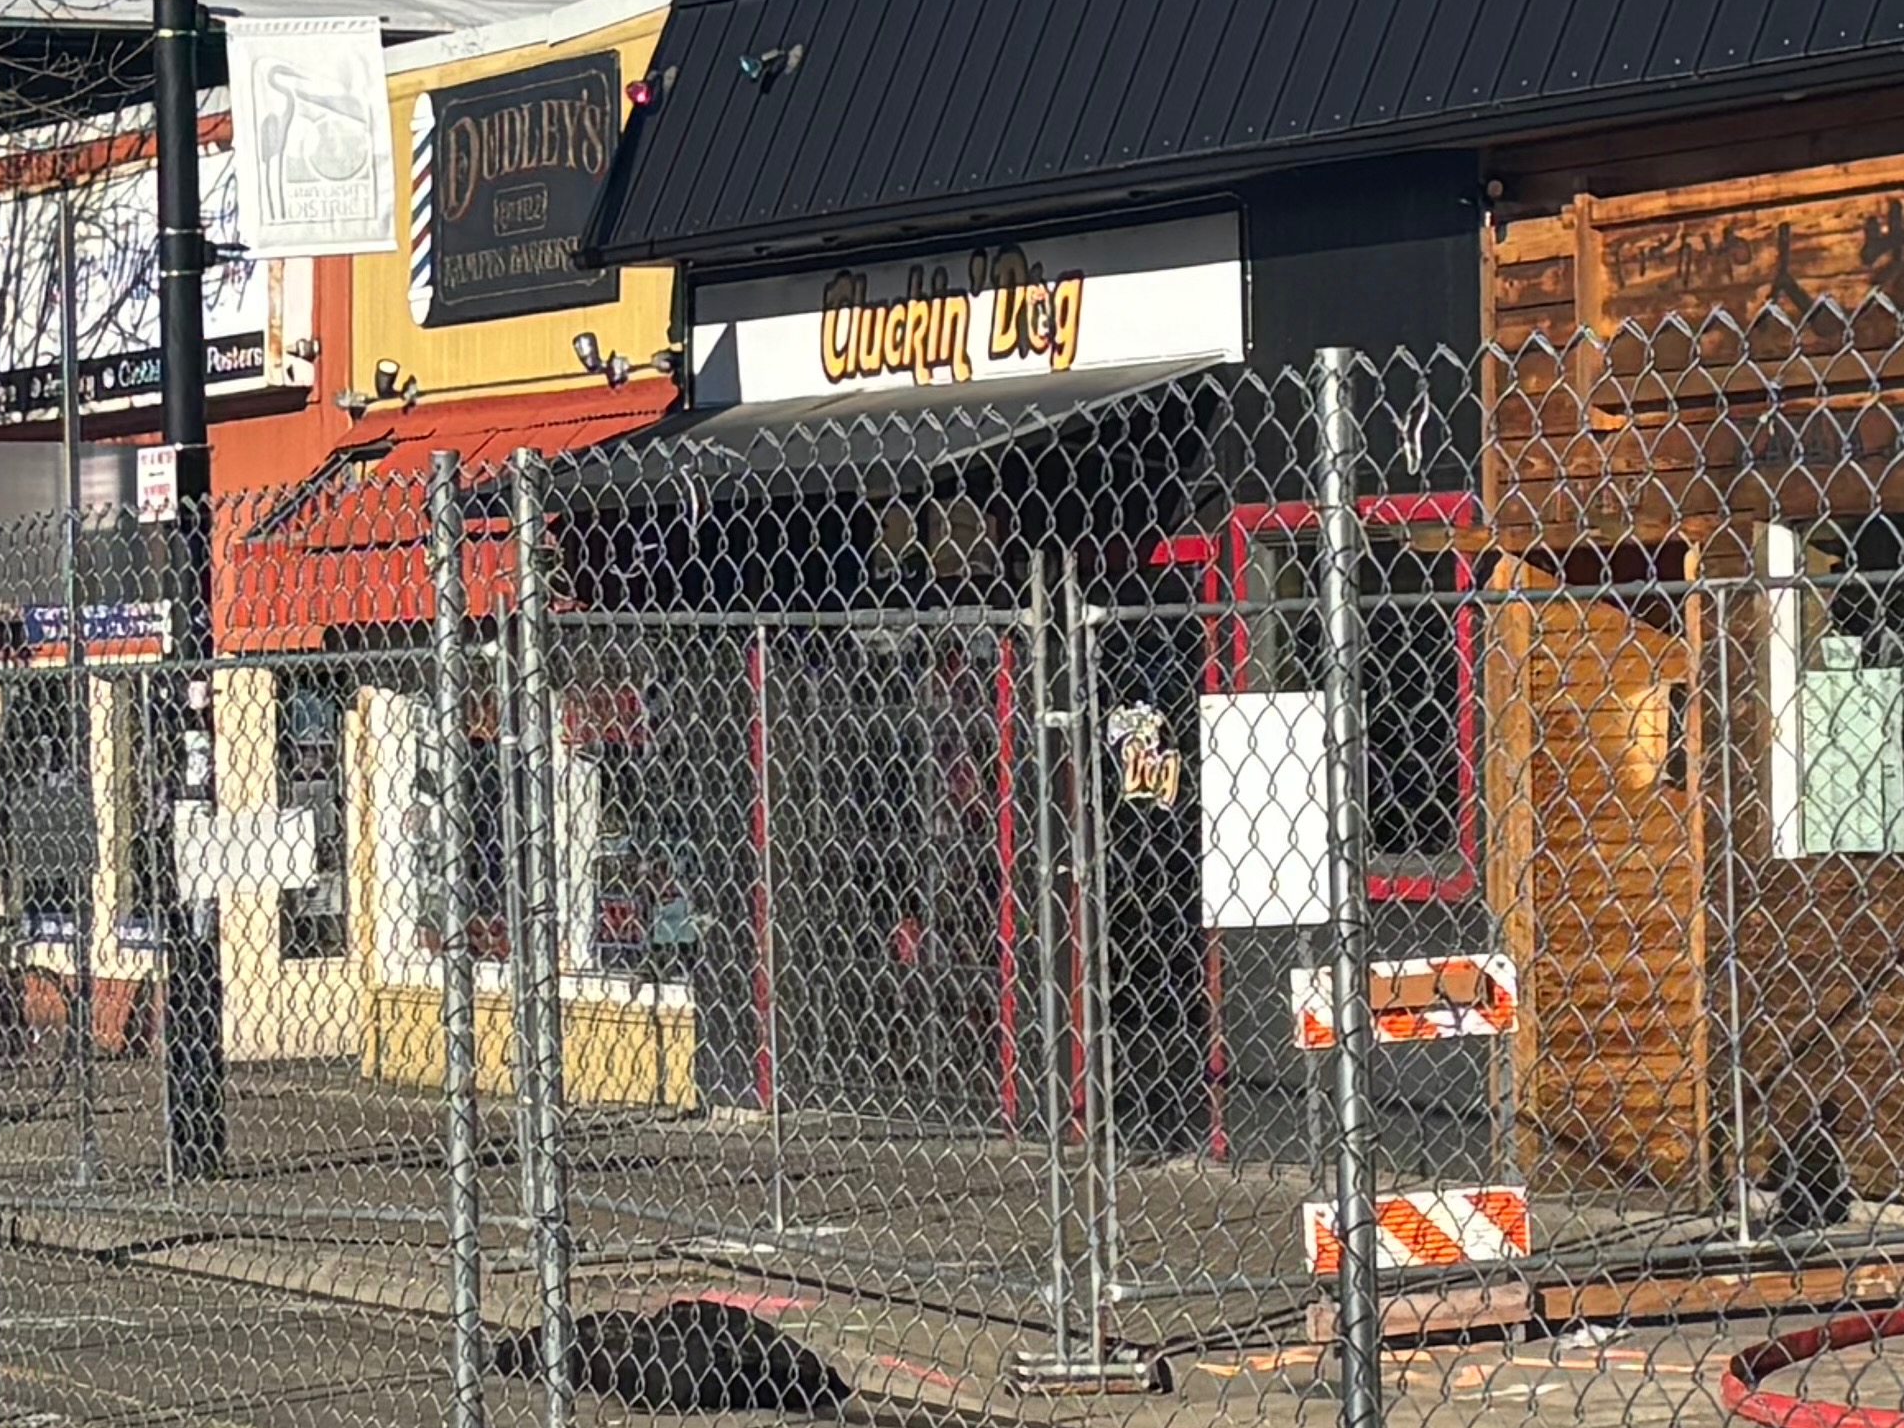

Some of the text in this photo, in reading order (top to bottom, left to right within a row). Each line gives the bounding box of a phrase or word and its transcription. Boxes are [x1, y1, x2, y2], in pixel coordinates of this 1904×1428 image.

[444, 88, 604, 221] DUDLEY'S
[207, 343, 263, 373] Posters
[821, 242, 1085, 386] Cluckin' Dog
